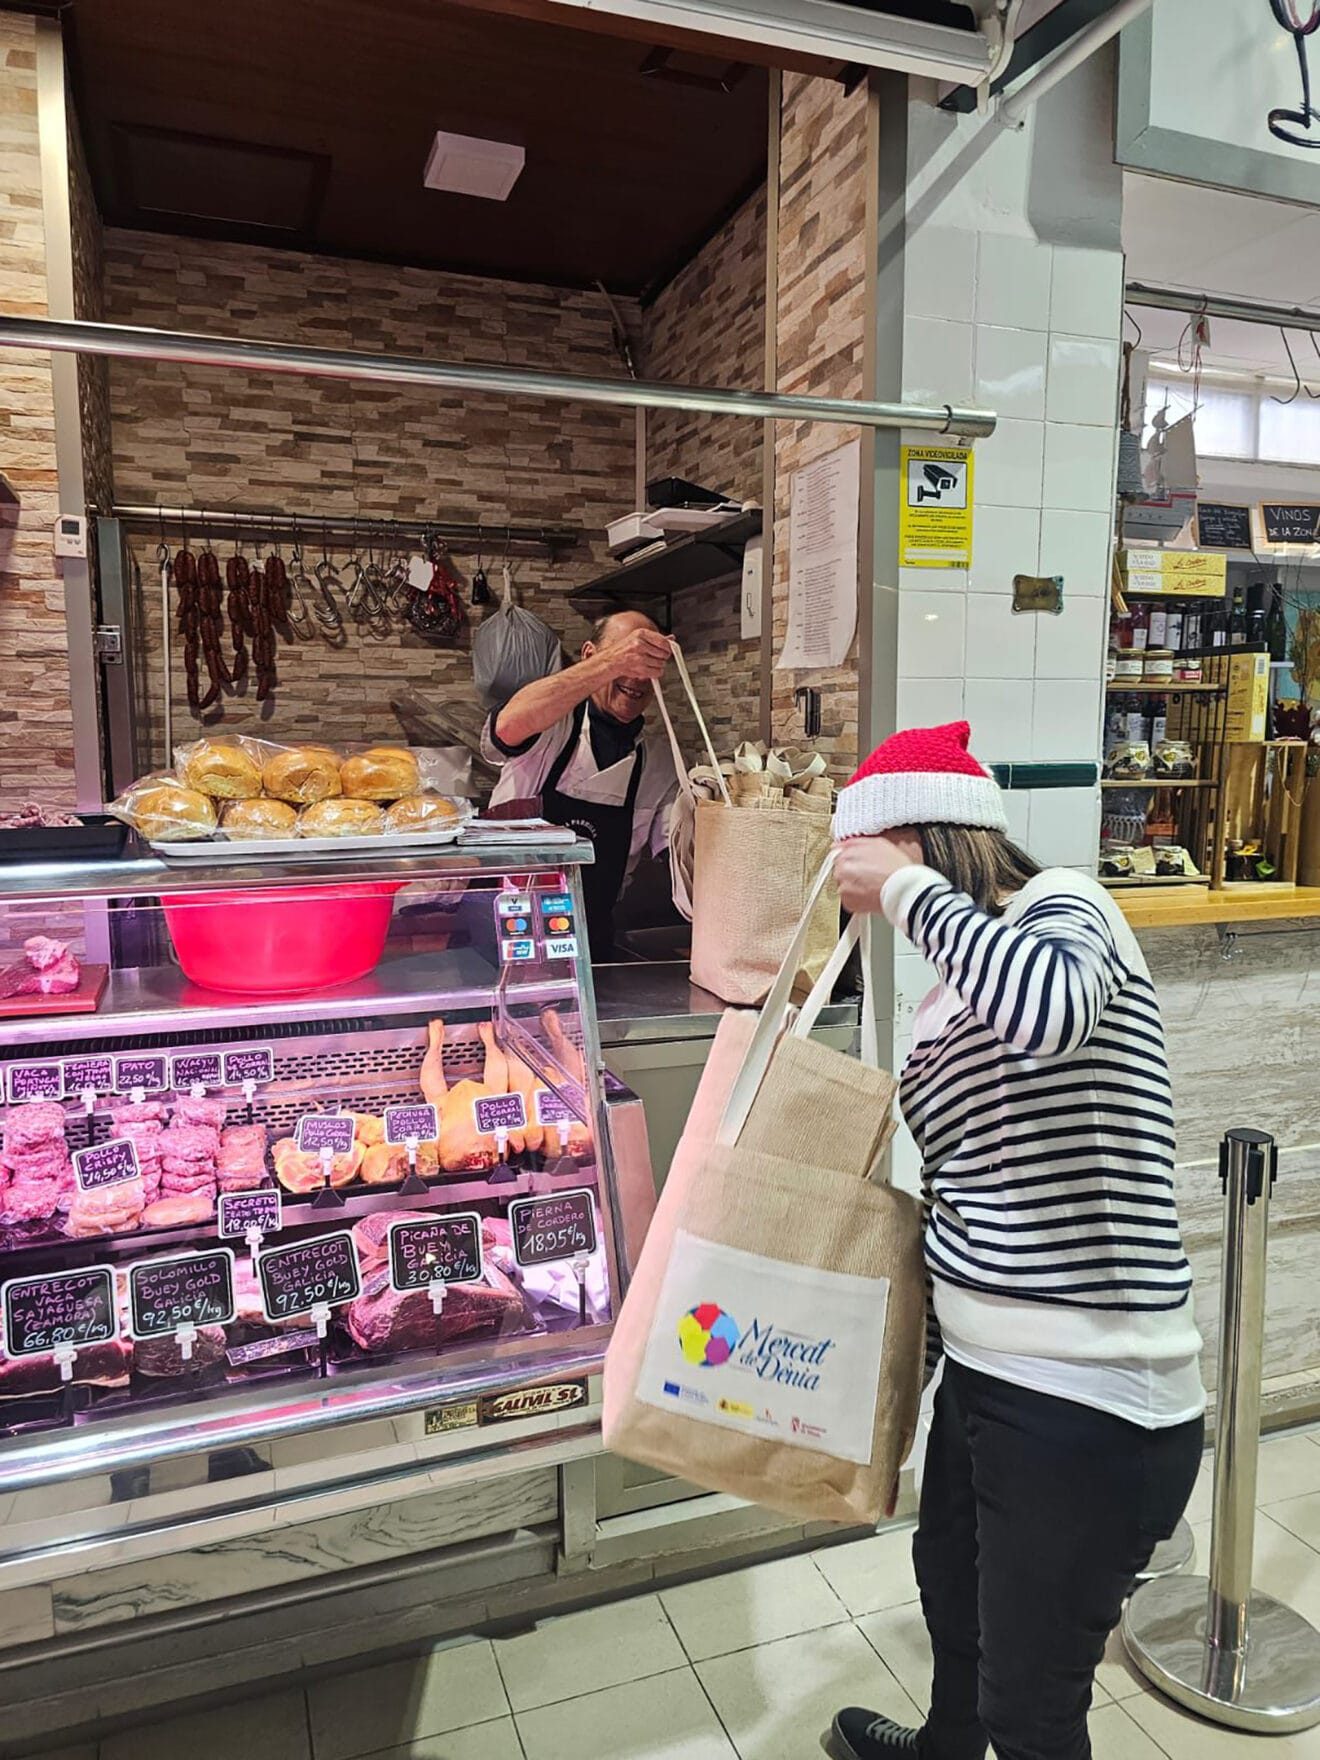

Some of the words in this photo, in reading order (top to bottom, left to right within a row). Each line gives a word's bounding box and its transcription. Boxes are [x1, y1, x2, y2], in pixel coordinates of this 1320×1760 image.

[1270, 507, 1311, 521] VINOS
[551, 944, 574, 953] VISA
[121, 1061, 155, 1073] PATO
[229, 1054, 262, 1064] POLLO
[14, 1070, 48, 1079] VACA
[478, 1100, 516, 1113] POLLO
[83, 1152, 126, 1171] CRISPY
[84, 1146, 120, 1163] POLLO
[519, 1202, 573, 1222] PIERNA
[451, 1223, 472, 1235] DE
[518, 1224, 533, 1234] DE
[537, 1212, 585, 1228] CORDERO
[265, 1240, 349, 1274] ENTRECOT
[136, 1261, 217, 1286] SOLOMILLO
[271, 1264, 310, 1285] BUEY
[314, 1254, 348, 1271] GOLD
[11, 1275, 101, 1301] ENTRECOT
[141, 1282, 180, 1300] BUEY
[184, 1273, 221, 1291] GOLD
[282, 1270, 336, 1293] GALICIA
[153, 1290, 207, 1309] GALICIA
[738, 1316, 836, 1365] Mercat
